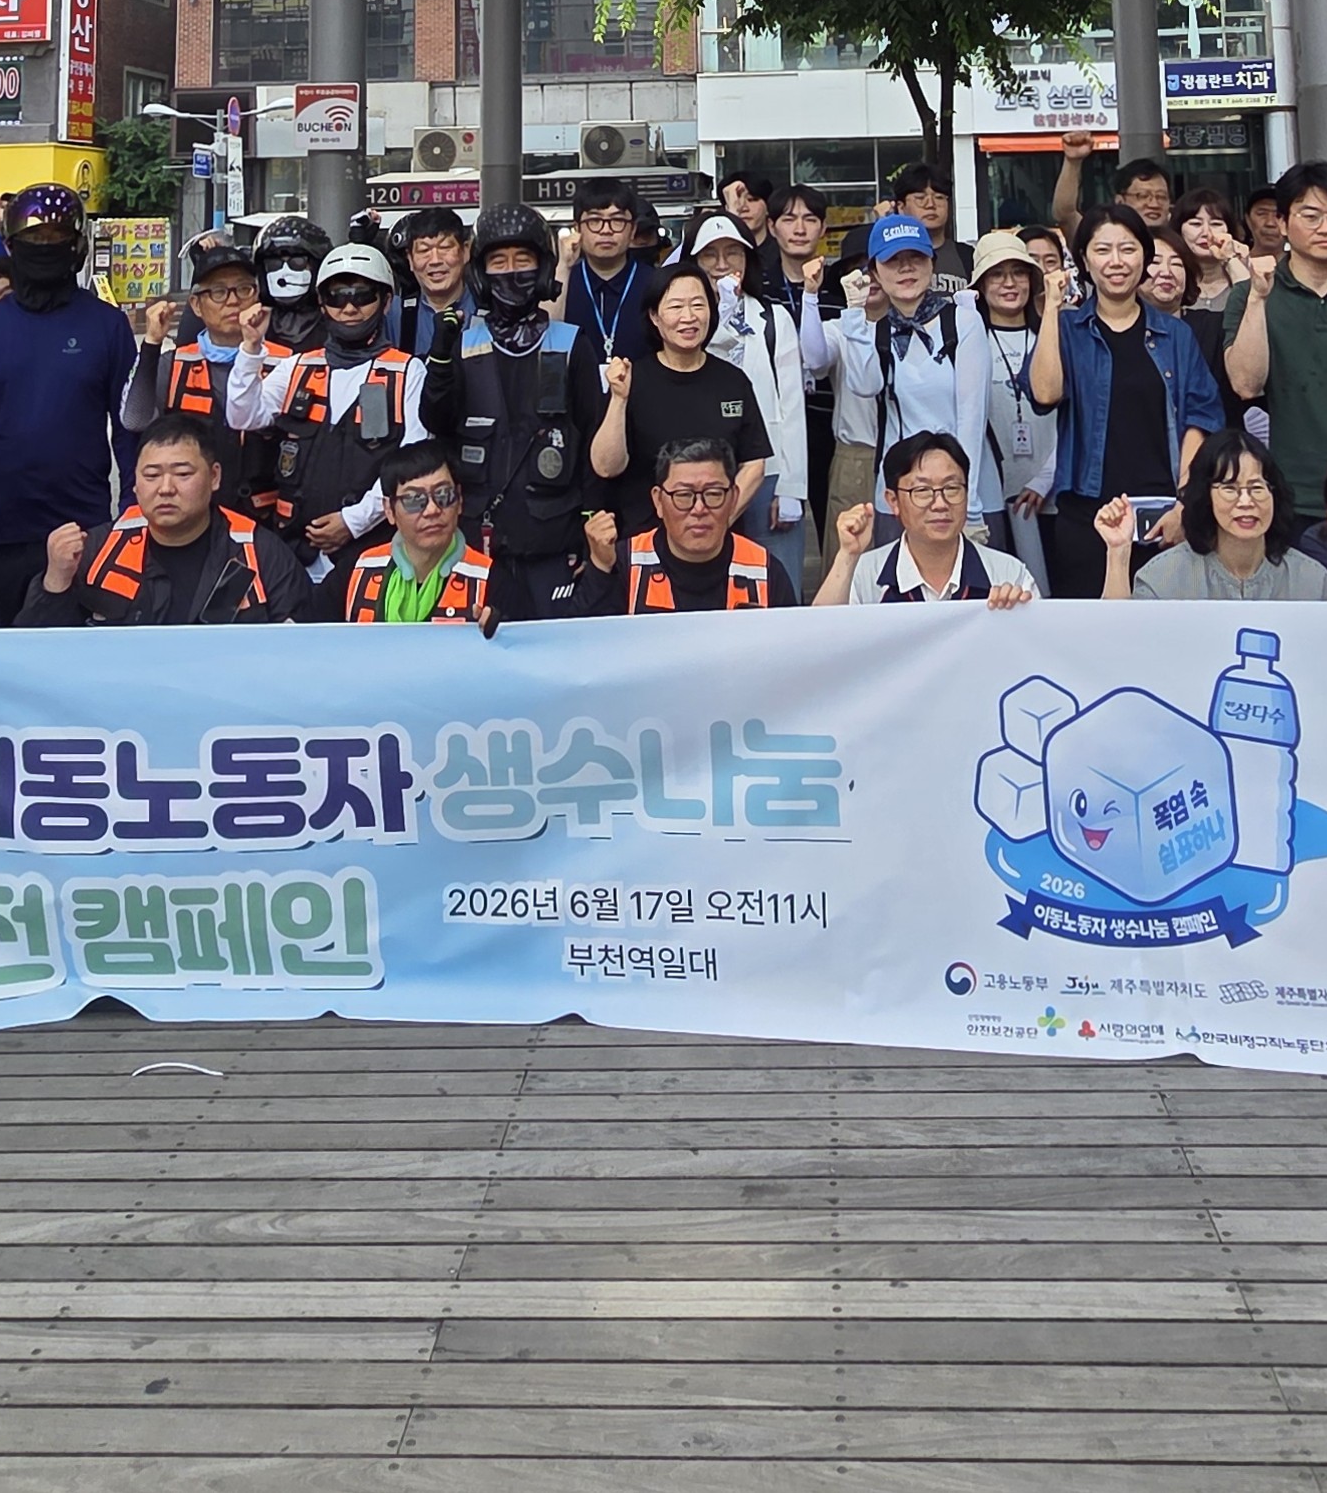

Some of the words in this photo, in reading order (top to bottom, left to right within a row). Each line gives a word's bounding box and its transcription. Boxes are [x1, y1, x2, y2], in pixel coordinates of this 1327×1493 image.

[297, 122, 352, 133] BUCHEON
[537, 180, 576, 199] H19
[433, 718, 843, 828] 생수나눔
[1152, 788, 1187, 832] 폭염
[1190, 779, 1210, 811] 속
[1157, 810, 1226, 875] 쉼표하나
[1039, 873, 1086, 900] 2026
[71, 876, 375, 977] 캠페인
[447, 888, 560, 921] 2026년
[569, 888, 620, 923] 6월
[629, 889, 695, 924] 17일
[705, 891, 829, 930] 오전11시
[1034, 904, 1107, 938] 이동노동자
[1109, 917, 1170, 940] 생수나눔
[1172, 909, 1219, 937] 캠페인
[567, 944, 718, 982] 부천역일대
[984, 973, 1048, 990] 고용노동부
[1066, 975, 1100, 996] Jeju
[1109, 978, 1208, 999] 제주특별자치도
[967, 1024, 1038, 1040] 안전보건공단
